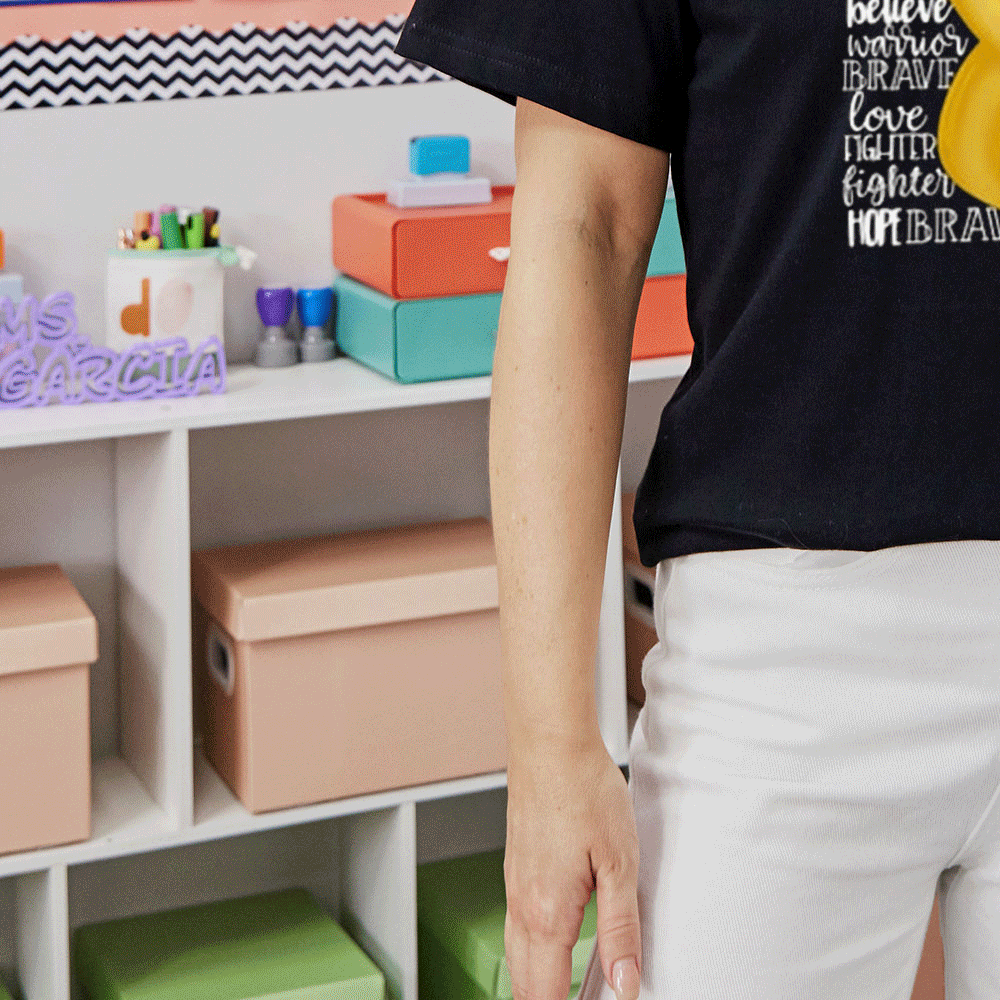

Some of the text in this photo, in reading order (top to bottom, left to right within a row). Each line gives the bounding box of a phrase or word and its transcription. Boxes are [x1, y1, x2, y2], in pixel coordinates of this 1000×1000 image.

[848, 24, 969, 58] warrior
[842, 57, 959, 91] BRAVE
[849, 90, 928, 132] love
[844, 132, 937, 162] FIGHTER
[842, 164, 955, 207] fighter
[848, 207, 902, 248] HOPE
